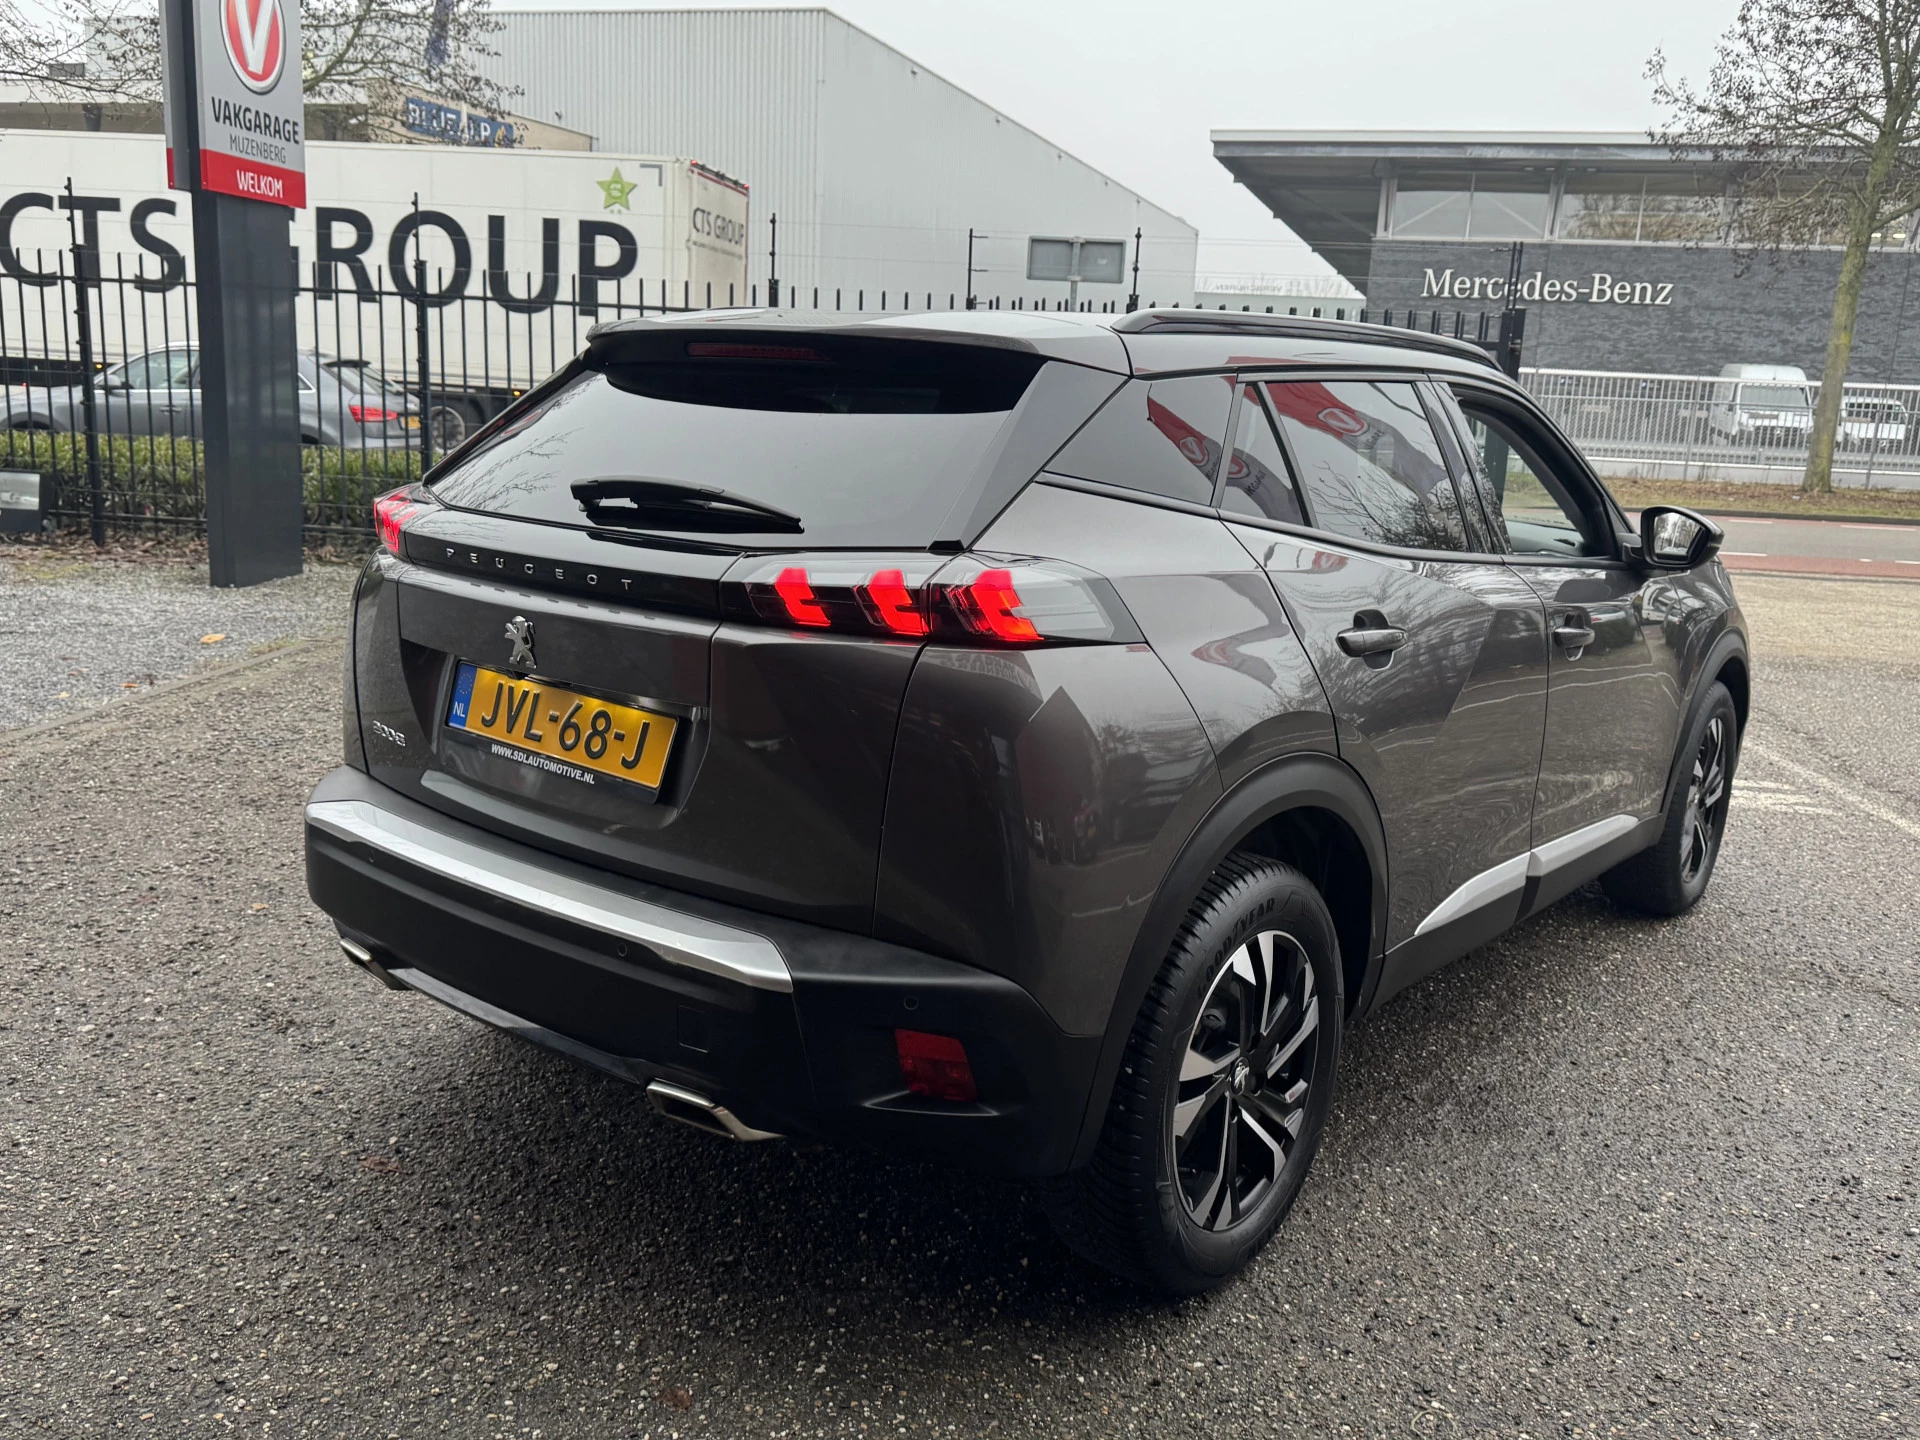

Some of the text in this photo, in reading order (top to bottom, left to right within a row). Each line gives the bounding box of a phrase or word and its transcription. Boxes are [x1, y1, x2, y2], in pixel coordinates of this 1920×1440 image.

[211, 96, 300, 144] VAKGARAGE
[229, 133, 287, 164] MUZENBERG
[236, 169, 284, 198] WELKOM
[693, 207, 744, 246] CTS GROUP
[0, 192, 639, 316] CTS ROUP
[1420, 268, 1674, 305] Mercedes-Benz
[446, 548, 632, 590] PEUGEOT
[453, 701, 466, 718] NL
[481, 681, 650, 770] JVL-68-J
[491, 743, 595, 785] WWW.SDLAUTOMOTIVE.NL
[1198, 897, 1275, 997] GOODYEAR
